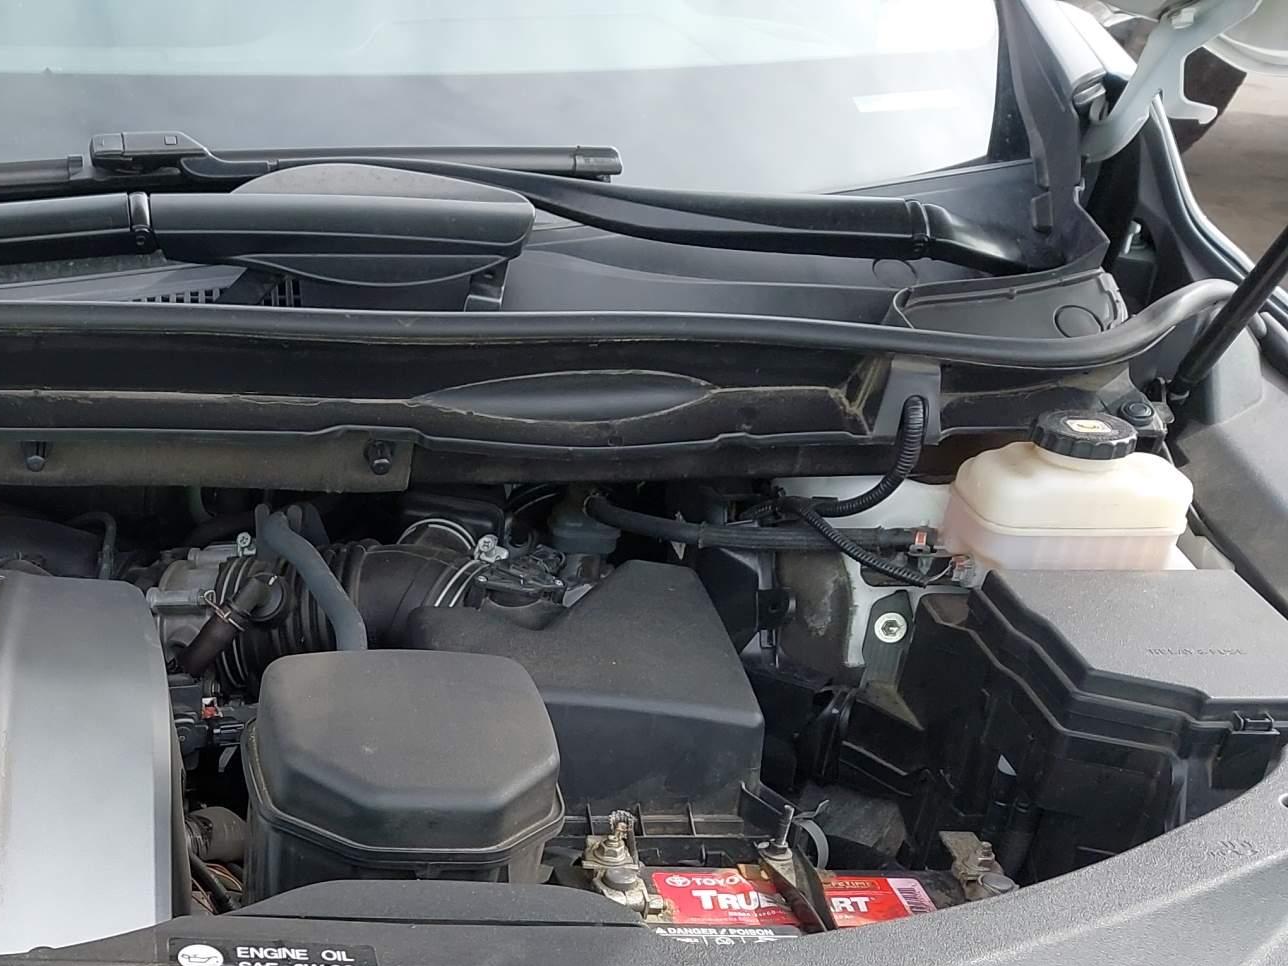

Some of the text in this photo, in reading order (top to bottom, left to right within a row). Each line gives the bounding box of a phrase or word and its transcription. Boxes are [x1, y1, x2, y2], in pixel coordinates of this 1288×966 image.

[691, 873, 749, 887] TOYO
[667, 927, 718, 936] DANGER
[728, 928, 775, 937] POISON
[236, 946, 355, 962] ENGINE OIL
